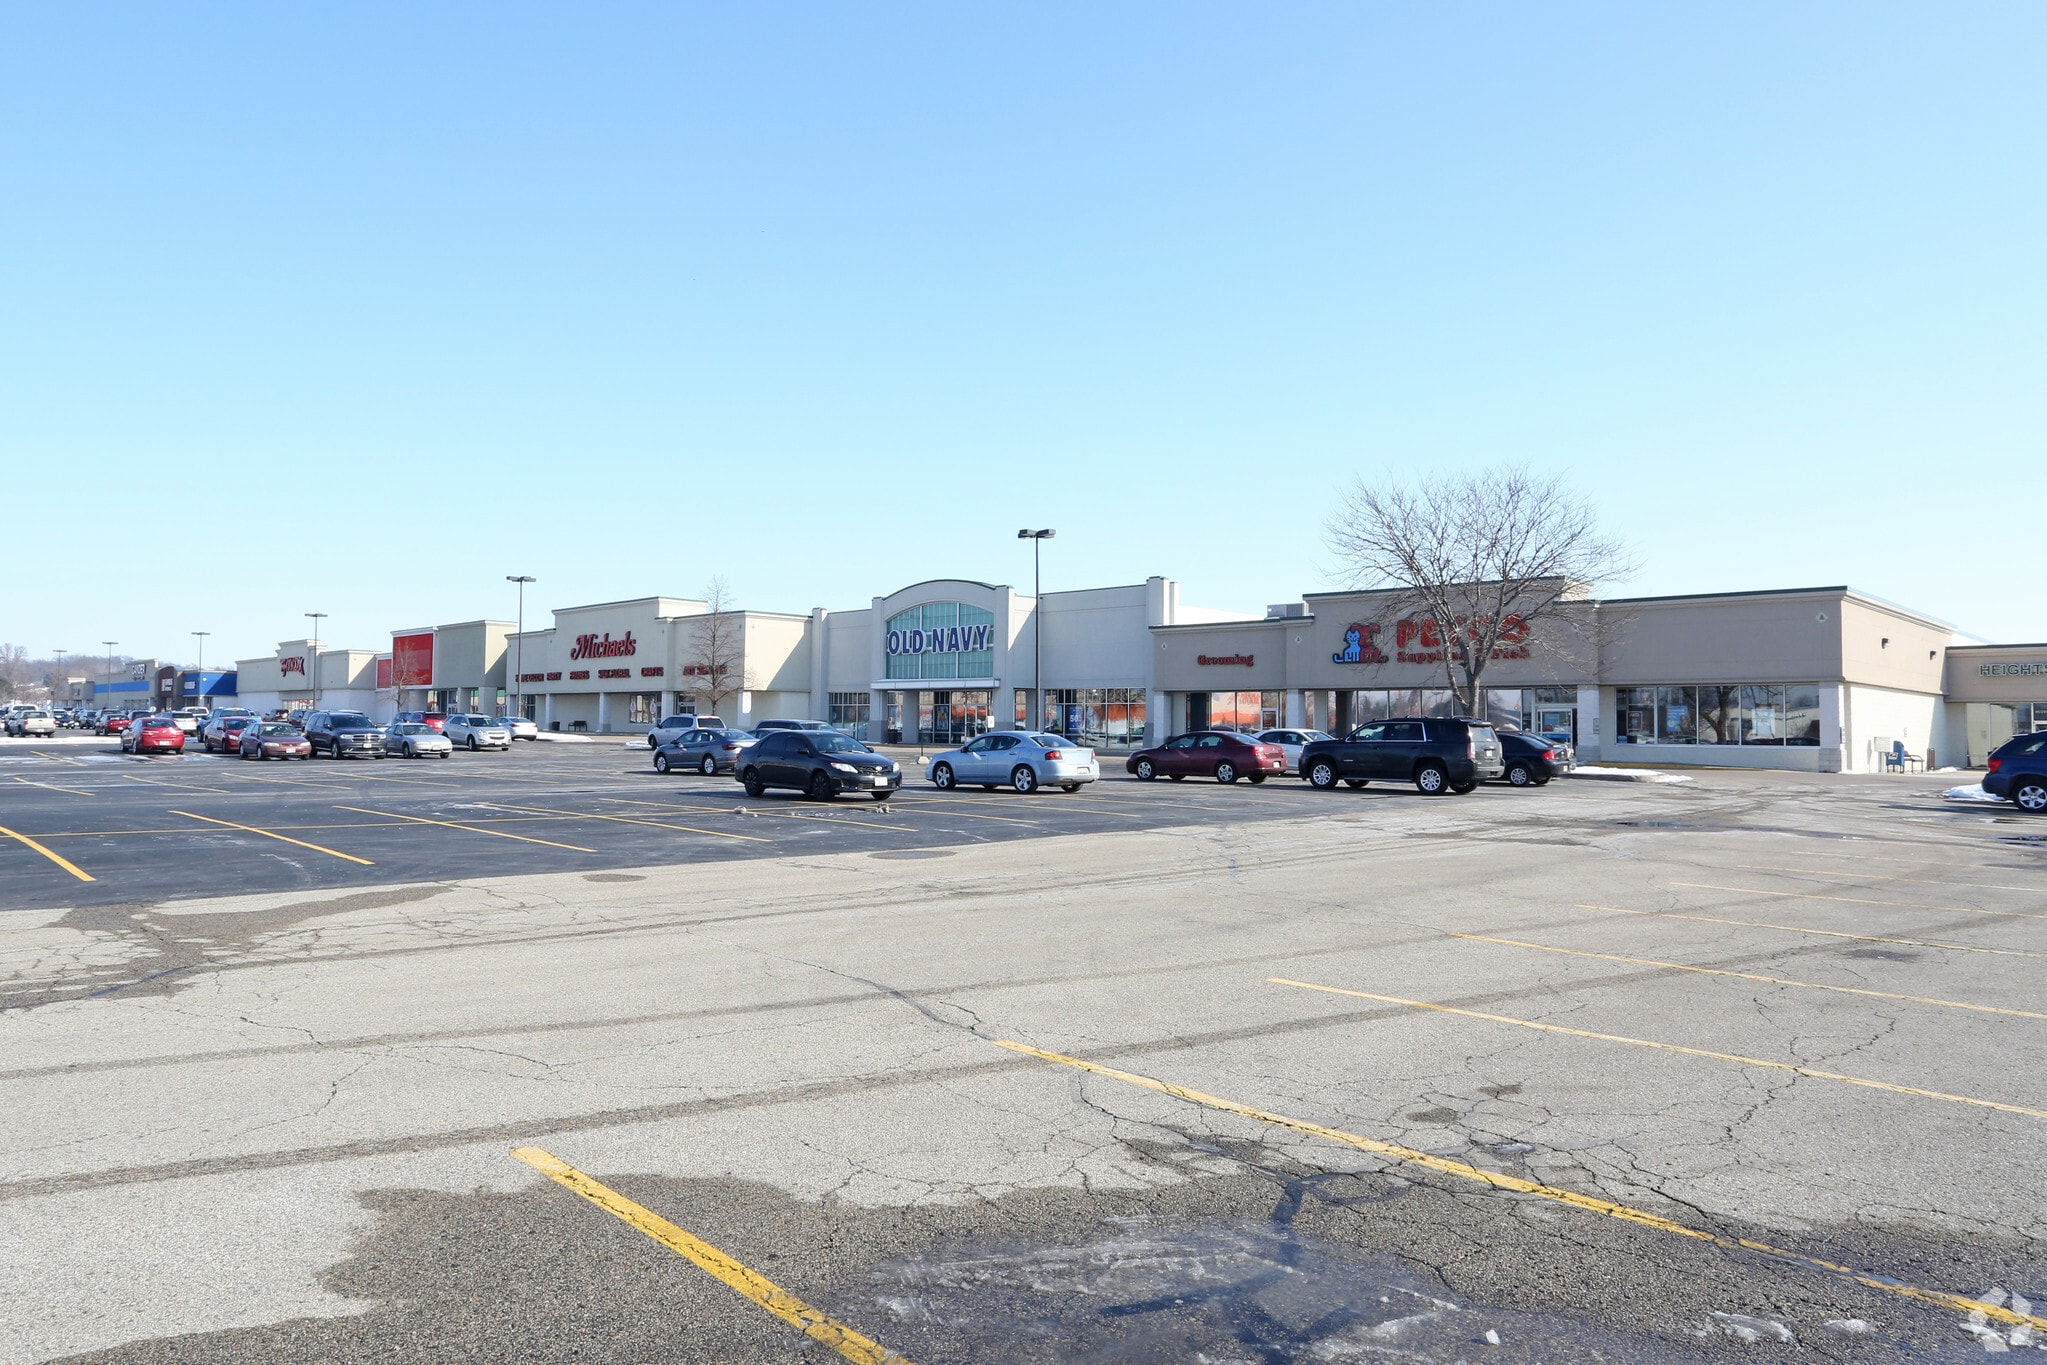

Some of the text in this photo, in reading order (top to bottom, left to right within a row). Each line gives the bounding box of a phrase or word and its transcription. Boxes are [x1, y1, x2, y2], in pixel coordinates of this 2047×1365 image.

[570, 631, 637, 660] Michaels
[888, 624, 990, 655] OLD NAVY
[1197, 653, 1254, 667] Grooming
[1396, 650, 1465, 664] Supples
